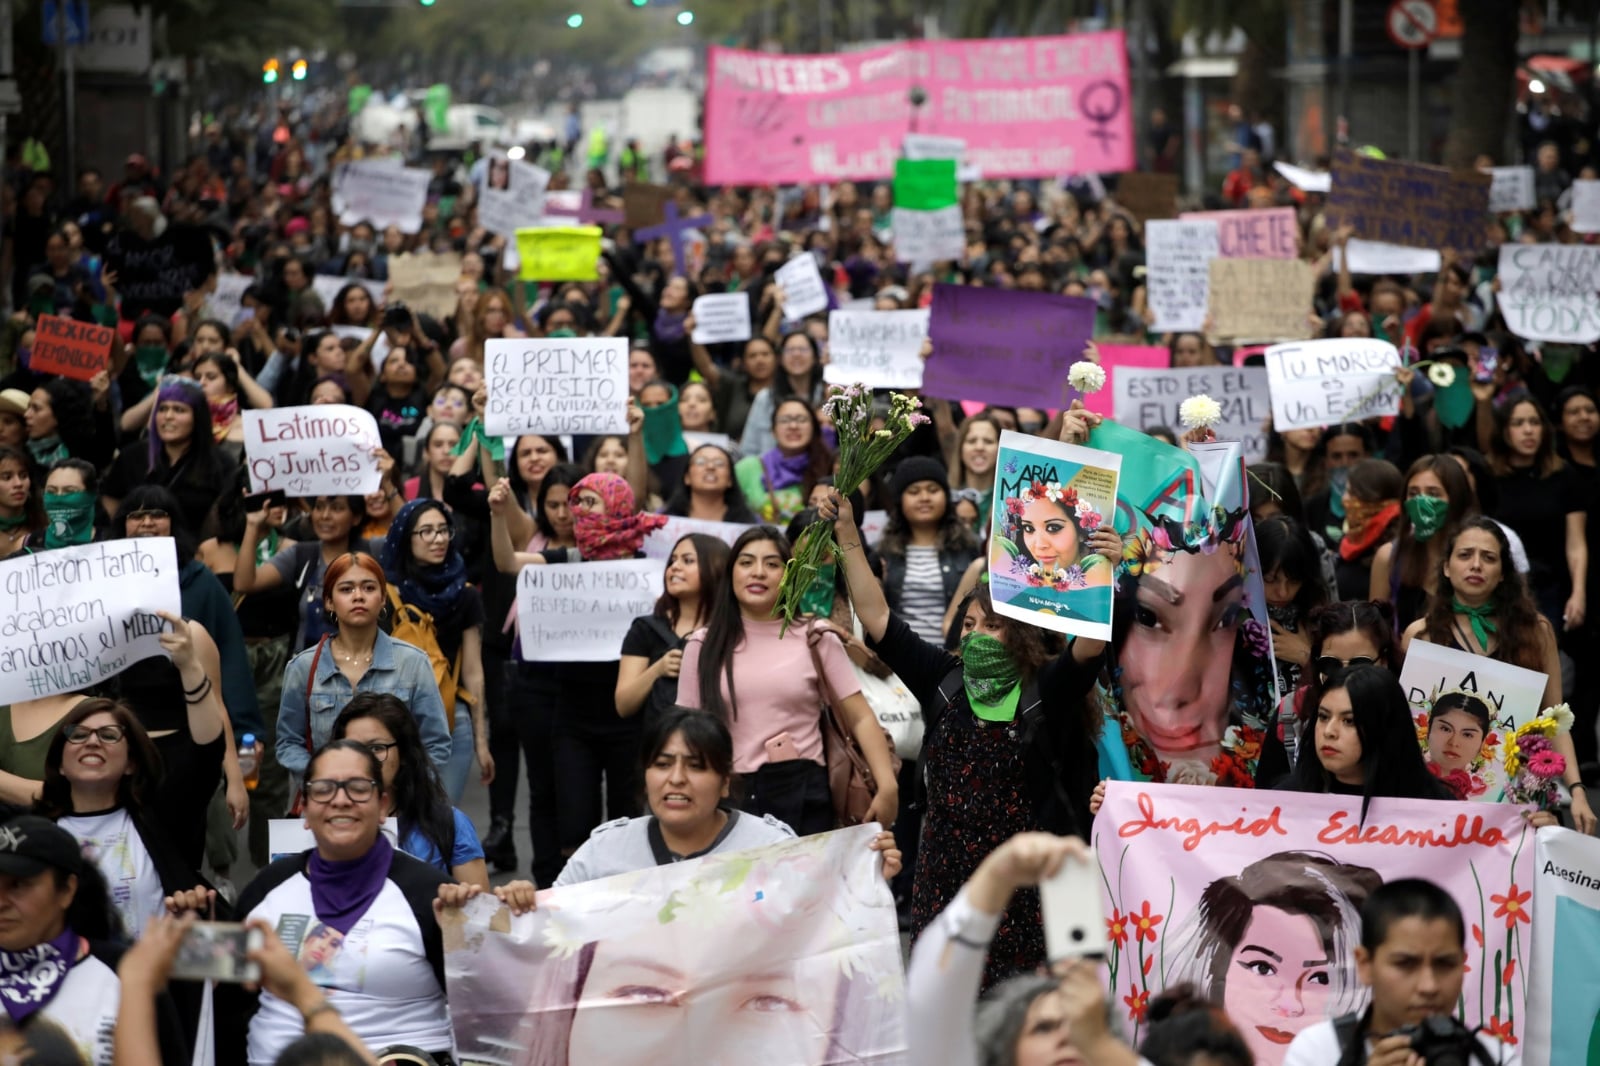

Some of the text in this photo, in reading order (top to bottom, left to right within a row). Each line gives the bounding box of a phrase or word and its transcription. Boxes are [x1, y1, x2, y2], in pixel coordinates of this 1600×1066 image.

[492, 347, 621, 375] EL PRIMER
[490, 376, 616, 401] REQUISITO
[1127, 371, 1253, 398] ESTO ES EL
[491, 399, 514, 415] DE
[520, 397, 542, 415] LA
[1284, 400, 1319, 425] Un
[258, 413, 361, 443] Latimos
[507, 414, 619, 432] ES LA JUSTICIA
[279, 448, 361, 475] Juntas
[1001, 462, 1060, 501] MARÍA
[6, 541, 160, 611] quitaron tanto,
[524, 570, 652, 592] NI UNA MENOS
[530, 595, 588, 614] RESPETO
[591, 600, 602, 613] A
[607, 599, 623, 614] LA
[99, 615, 116, 653] el
[1408, 670, 1516, 732] DIANA
[1118, 792, 1510, 851] Ingrid Escamilla
